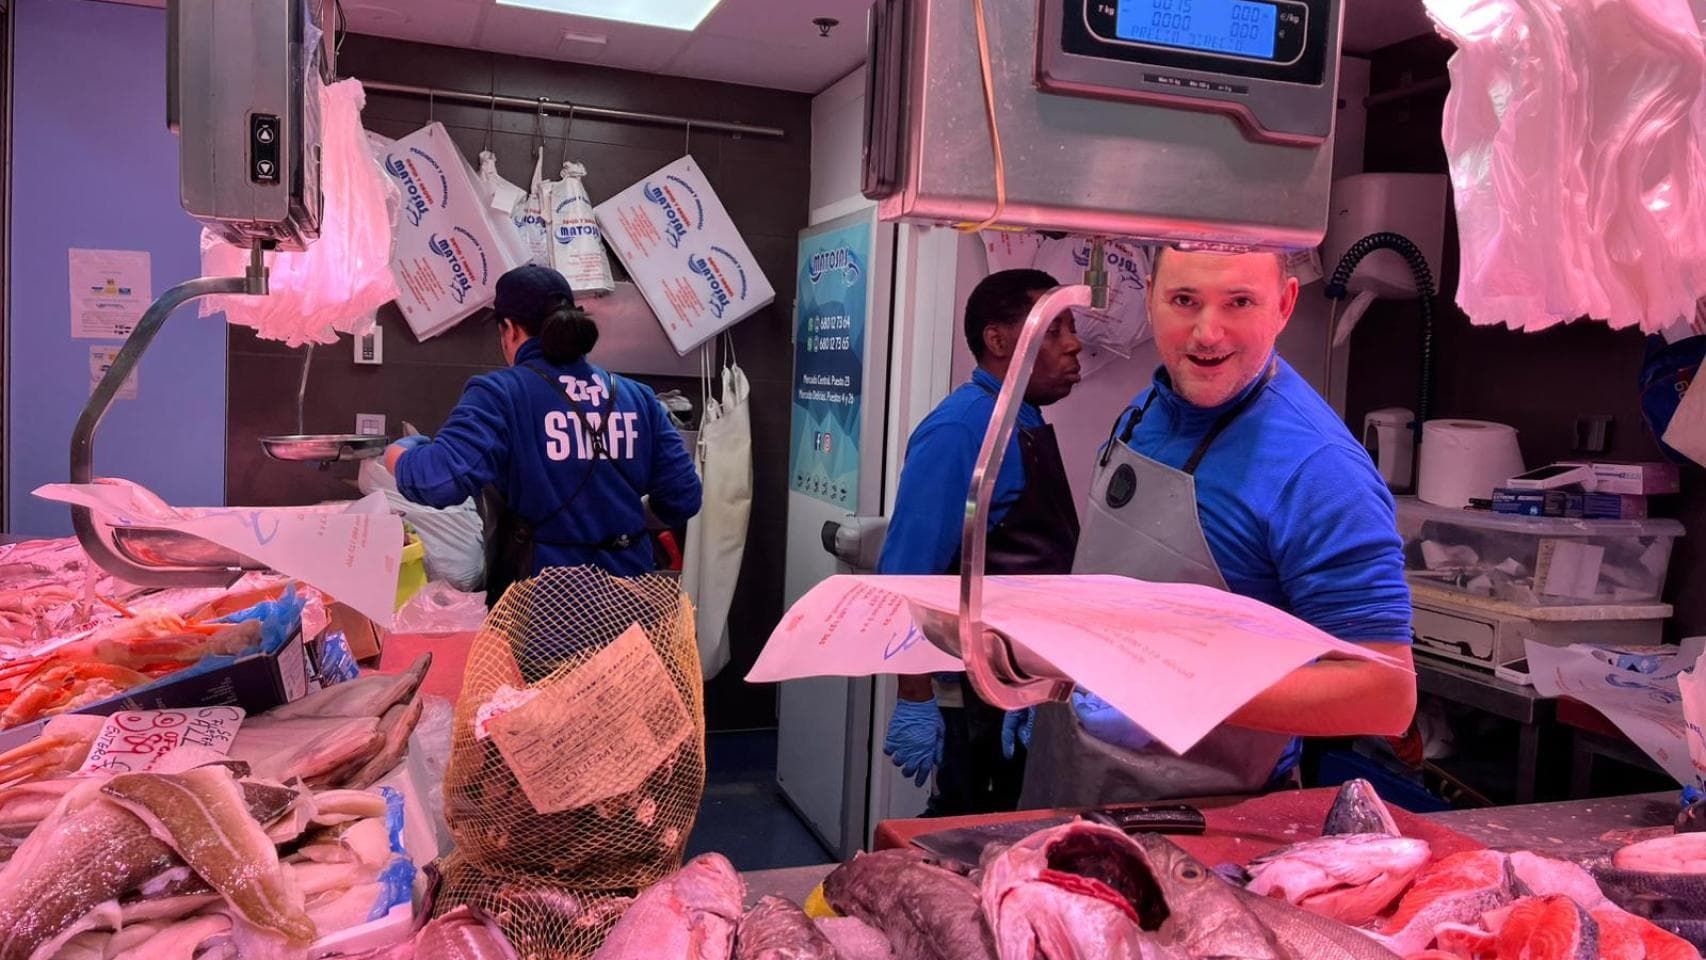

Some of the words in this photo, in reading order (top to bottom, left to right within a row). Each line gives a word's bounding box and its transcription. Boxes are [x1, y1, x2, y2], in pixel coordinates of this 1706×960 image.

[393, 159, 430, 214] MATOSAS
[651, 187, 687, 237] MATOSAS
[437, 239, 473, 291] MATOSAS
[696, 258, 730, 307] MATOSAS
[813, 247, 849, 273] MATOSAS
[544, 410, 639, 461] STAFF
[90, 724, 121, 762] ENTERO
